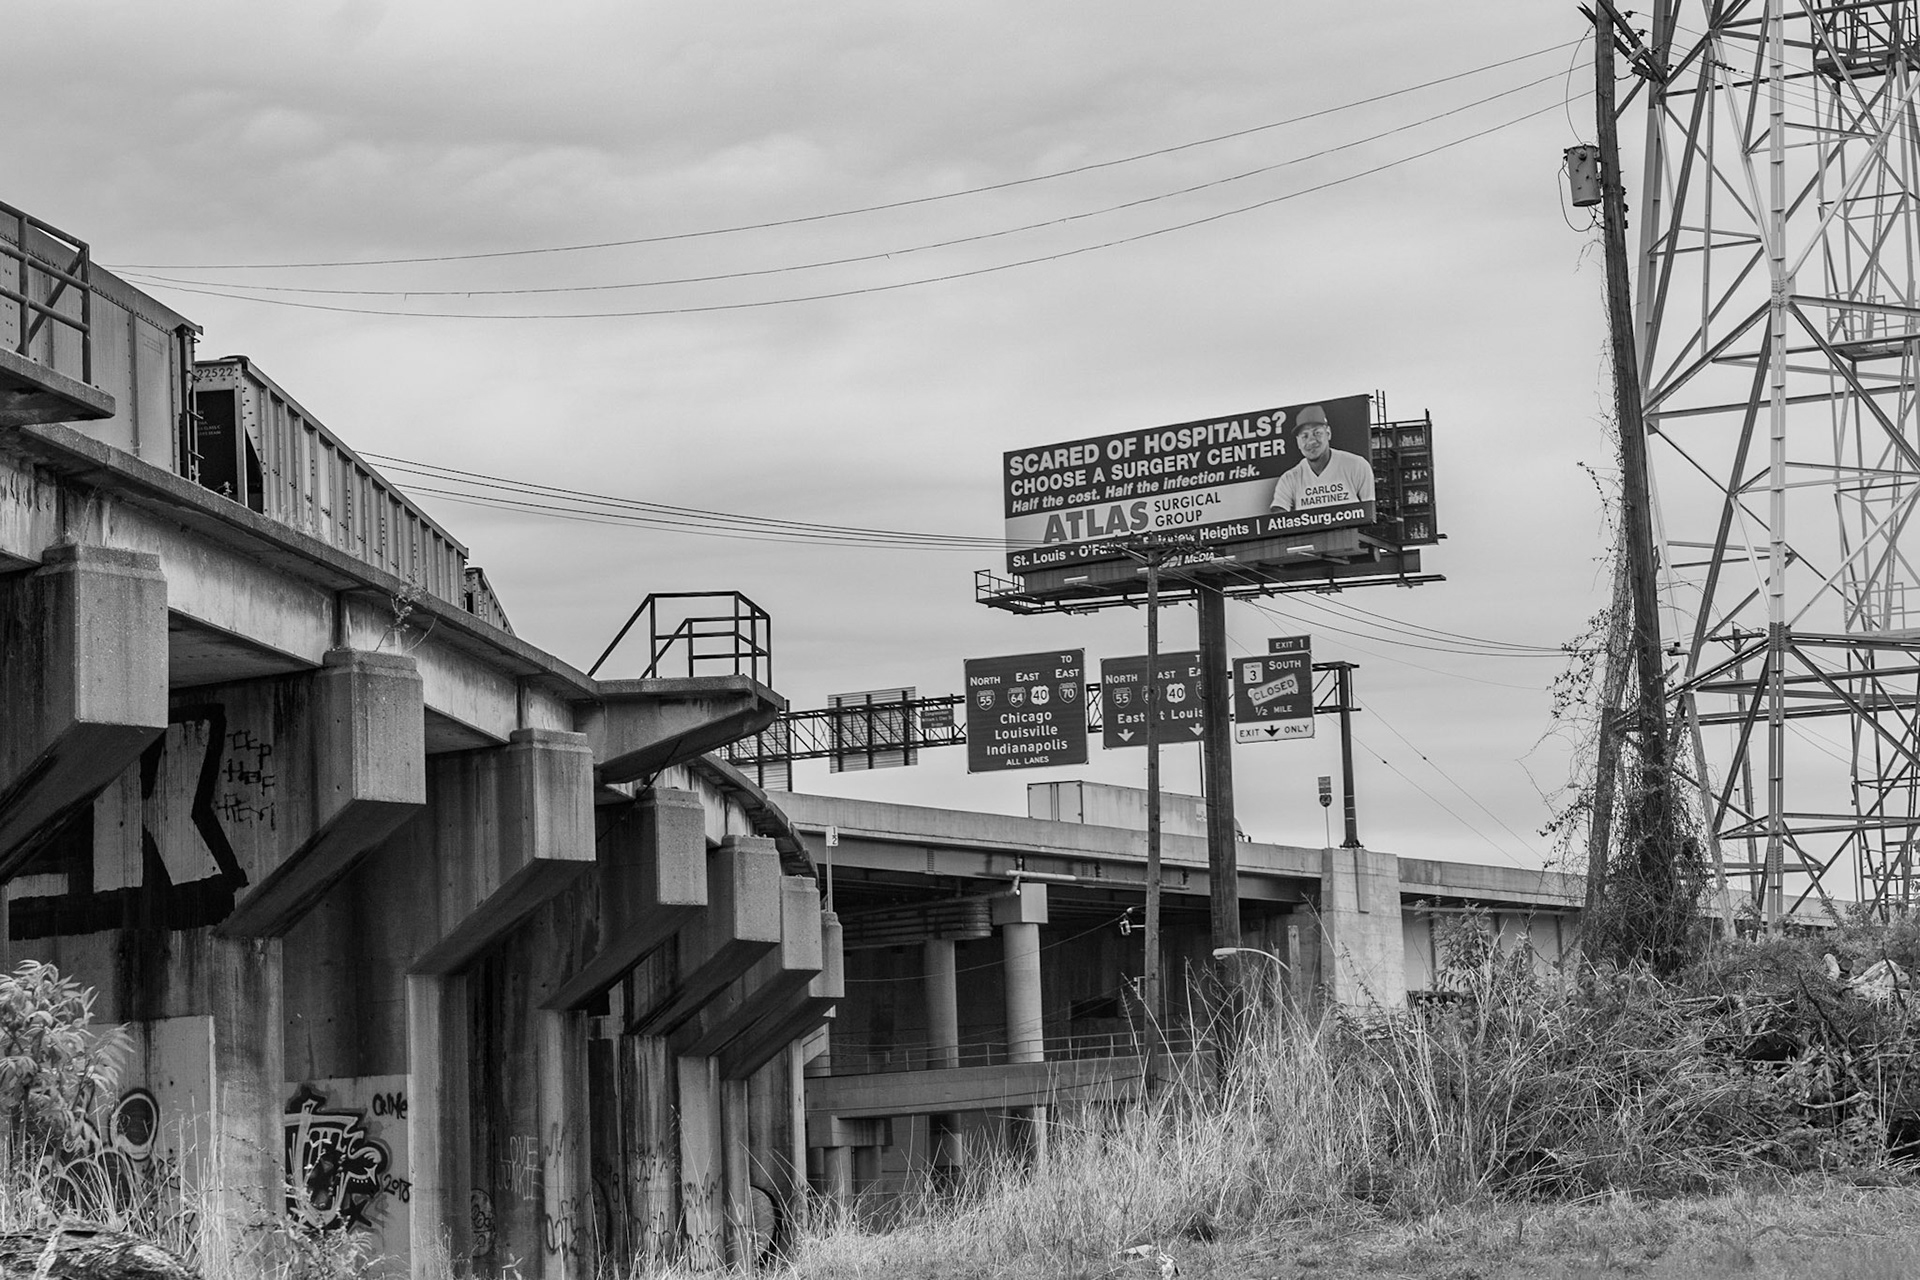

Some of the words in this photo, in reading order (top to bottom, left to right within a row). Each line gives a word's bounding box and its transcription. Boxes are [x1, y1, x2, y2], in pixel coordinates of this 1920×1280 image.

[1009, 443, 1100, 476] SCARED
[1106, 437, 1137, 460] OF
[1144, 411, 1287, 455] HOSPITALS?
[1010, 469, 1087, 496] CHOOSE
[1092, 467, 1106, 484] A
[1111, 451, 1201, 480] SURGERY
[1206, 438, 1286, 466] CENTER
[1011, 498, 1039, 513] Half
[1042, 495, 1064, 509] the
[1067, 489, 1101, 505] cost.
[1105, 483, 1133, 499] Half
[1136, 479, 1159, 494] the
[1163, 469, 1225, 490] infection
[1229, 463, 1260, 480] risk.
[1305, 483, 1344, 497] CARLOS
[1154, 491, 1221, 513] SURGICAL
[1300, 492, 1350, 506] MARTINEZ
[1043, 500, 1149, 544] ATLAS
[1155, 509, 1203, 528] GROUP
[1013, 555, 1030, 567] St.
[1033, 549, 1067, 564] Louis
[1199, 522, 1250, 541] Heights
[1267, 508, 1365, 532] AtlasSurg.com
[1275, 641, 1293, 649] EXIT
[1299, 638, 1304, 648] 1
[1060, 655, 1073, 663] TO
[1268, 659, 1302, 670] SOUTH
[969, 676, 1001, 687] NORTH
[1015, 672, 1040, 682] EAST
[1055, 668, 1080, 679] EAST
[1105, 673, 1138, 685] NORTH
[1157, 670, 1176, 679] AST
[1249, 669, 1257, 681] 3
[979, 695, 992, 706] 55
[1010, 693, 1023, 703] 64
[1032, 689, 1048, 699] 40
[1062, 688, 1075, 699] 70
[1115, 693, 1129, 704] 55
[1168, 687, 1184, 699] 40
[1253, 678, 1295, 702] CLOSED
[1117, 712, 1145, 724] East
[1171, 707, 1203, 720] Louis
[1273, 704, 1293, 713] MILE
[1000, 711, 1052, 725] Chicago
[995, 725, 1058, 740] Louisville
[1239, 728, 1260, 737] EXIT
[1284, 724, 1309, 734] ONLY
[986, 738, 1068, 756] Indianapolis
[1006, 758, 1021, 766] ALL
[1024, 756, 1050, 765] LANES
[500, 1134, 539, 1166] LOVE
